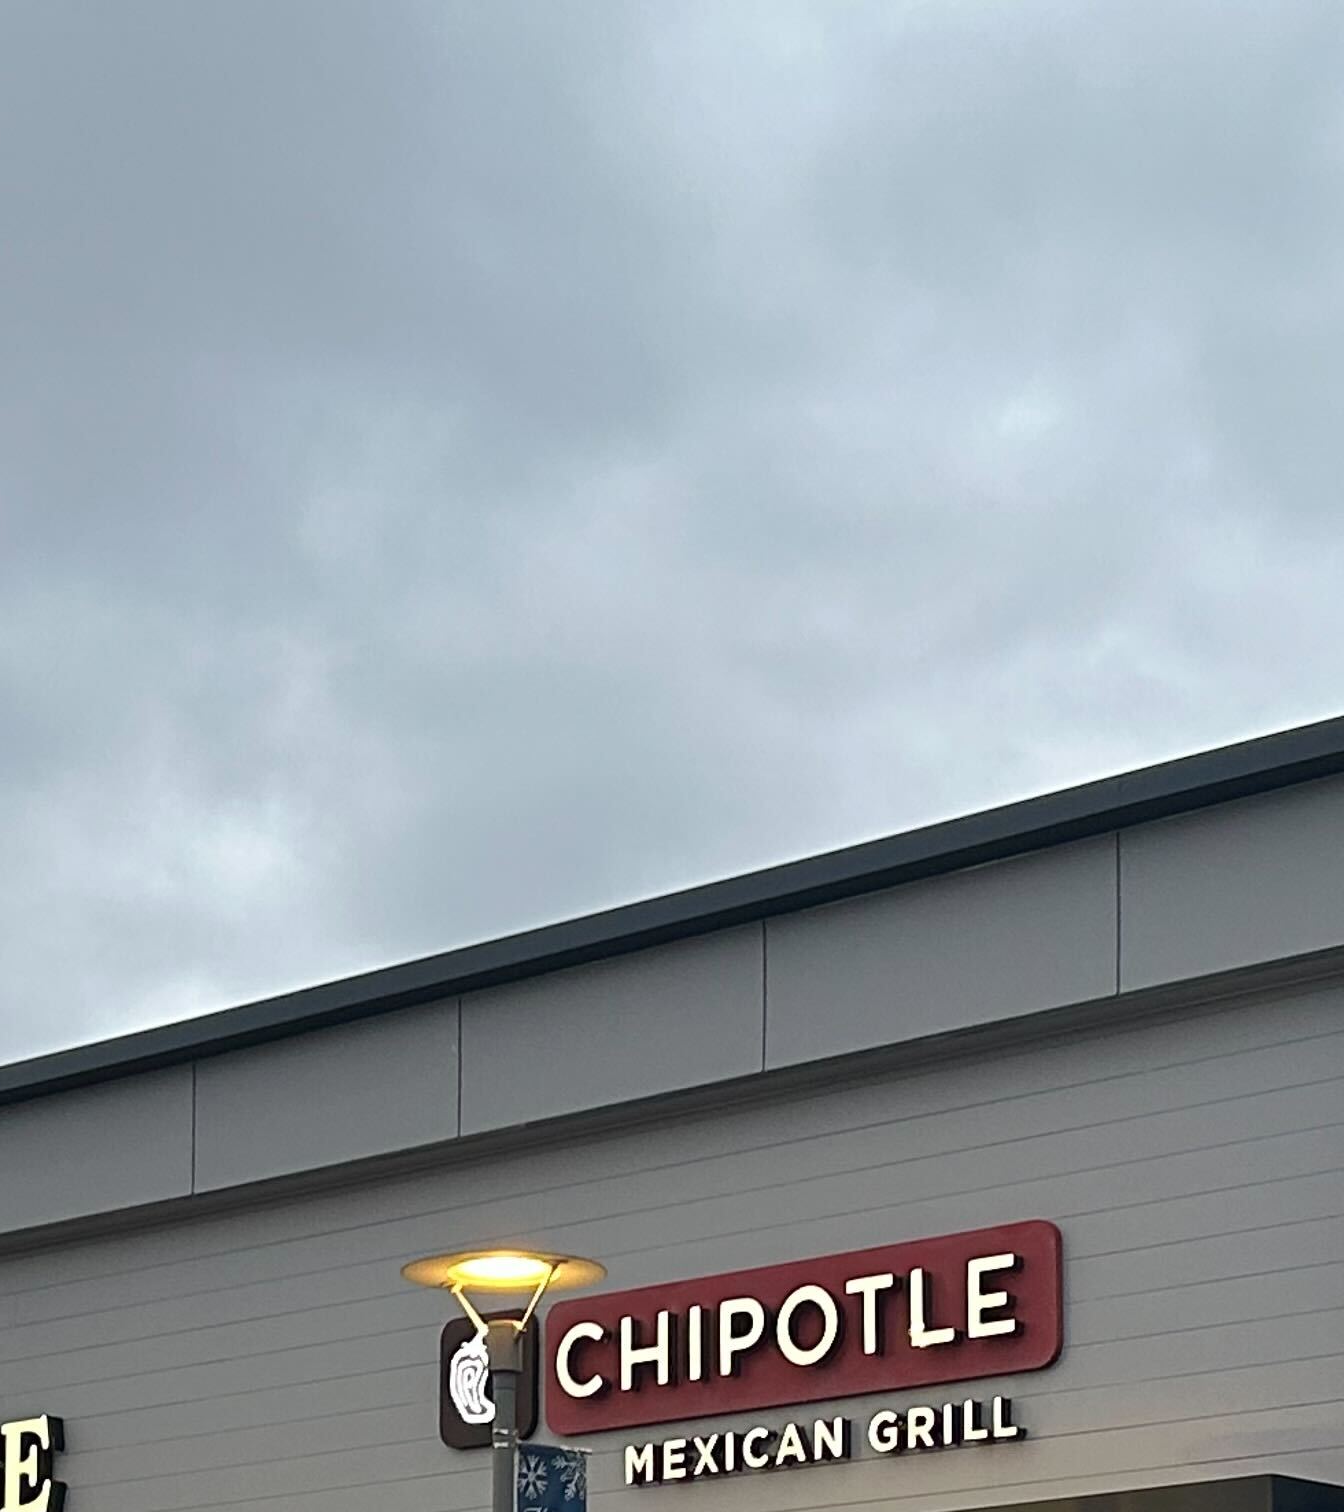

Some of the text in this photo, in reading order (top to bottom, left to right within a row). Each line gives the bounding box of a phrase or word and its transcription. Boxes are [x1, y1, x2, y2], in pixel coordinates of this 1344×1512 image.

[556, 1252, 1018, 1399] CHIPOTLE
[623, 1396, 1019, 1485] MEXICAN GRILL
